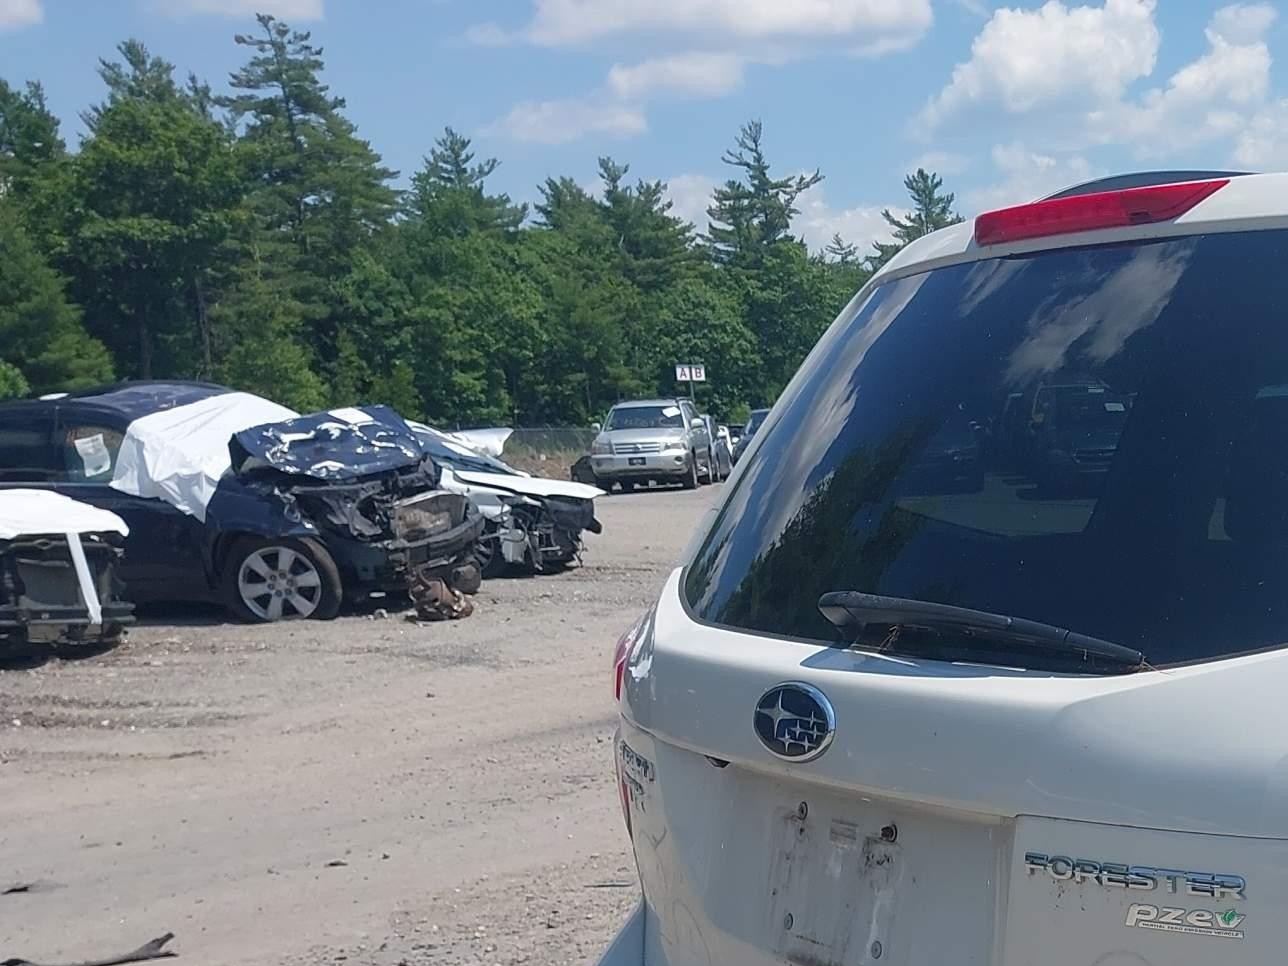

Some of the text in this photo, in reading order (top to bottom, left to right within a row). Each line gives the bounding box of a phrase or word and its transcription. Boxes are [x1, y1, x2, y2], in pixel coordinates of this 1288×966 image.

[680, 367, 688, 379] A
[694, 367, 702, 379] B
[1024, 851, 1247, 900] FORESTER
